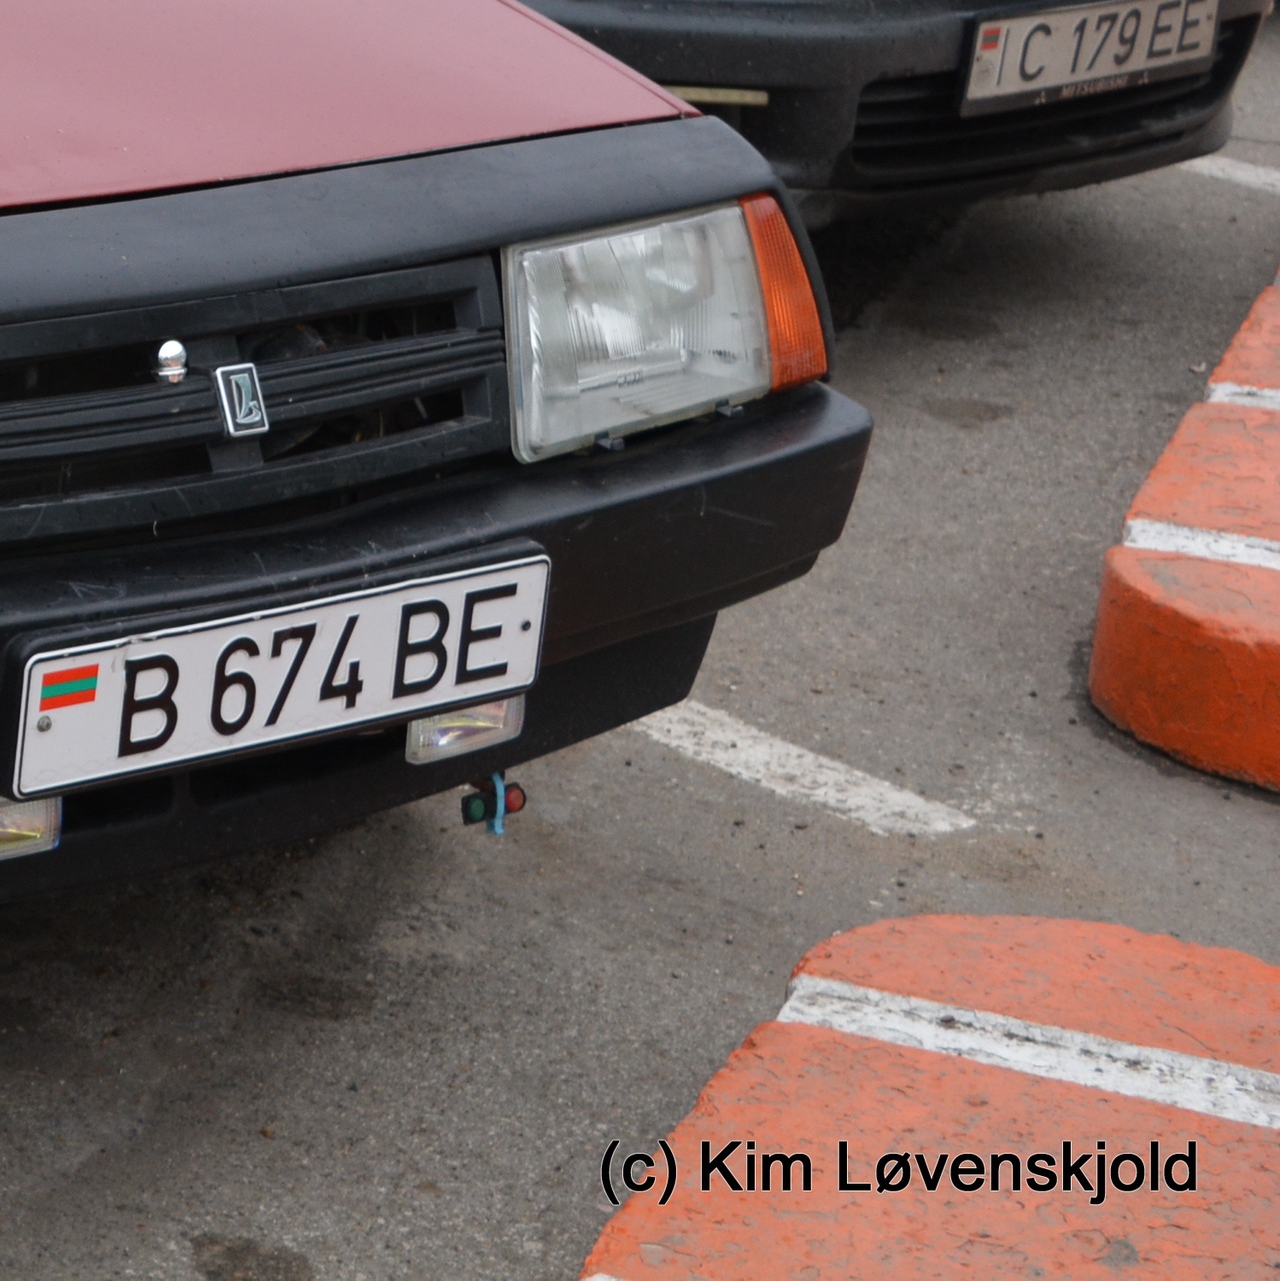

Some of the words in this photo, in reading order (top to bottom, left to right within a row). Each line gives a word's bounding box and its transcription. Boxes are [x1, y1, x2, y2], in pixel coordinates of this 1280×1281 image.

[1018, 23, 1052, 83] C
[1070, 7, 1142, 74] 179
[1059, 74, 1129, 99] MITSUBISHI
[117, 653, 180, 758] B
[209, 614, 364, 737] 674
[391, 582, 519, 700] BE
